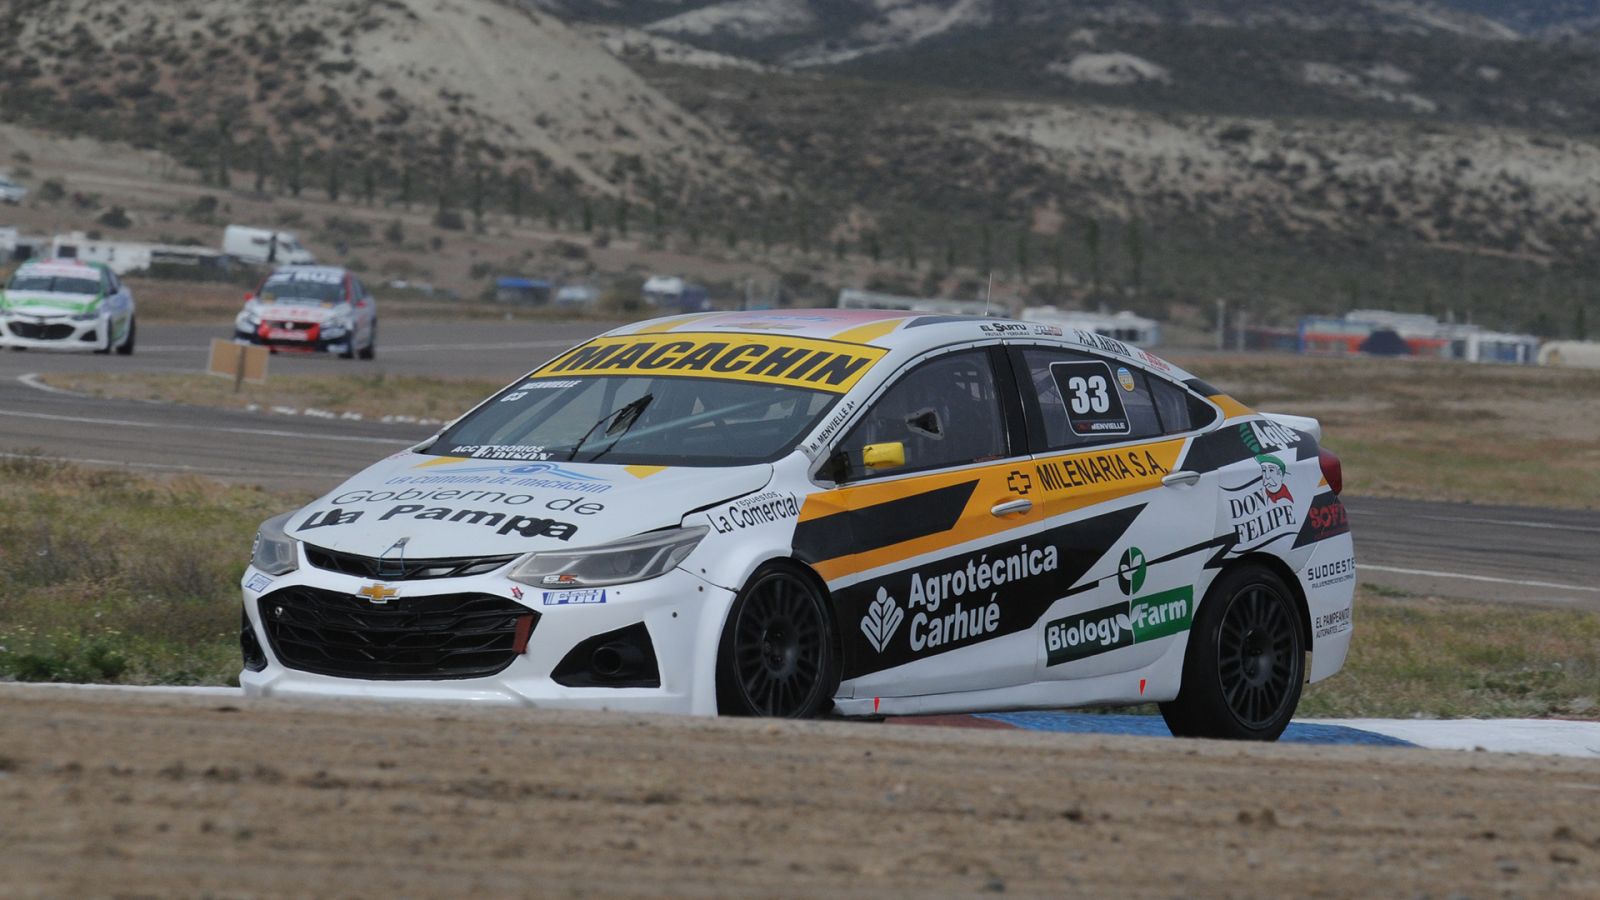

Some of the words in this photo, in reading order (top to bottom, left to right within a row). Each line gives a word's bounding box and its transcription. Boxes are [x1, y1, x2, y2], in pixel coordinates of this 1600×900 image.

[550, 341, 872, 386] MACACHIN
[1068, 375, 1110, 414] 33
[817, 407, 849, 444] MENVIELLE
[1036, 454, 1135, 492] MILENARIA
[1128, 450, 1168, 477] S.A.
[331, 486, 534, 505] Gobierno
[545, 496, 605, 516] de
[706, 513, 734, 534] La
[729, 491, 801, 529] Comercial
[735, 490, 778, 508] repuestos
[1228, 487, 1268, 519] DON
[1233, 504, 1297, 544] FELIPE
[908, 544, 1058, 612] Agrotécnica
[1308, 557, 1356, 581] SUDOESTE
[909, 592, 1001, 652] Carhué
[1048, 616, 1121, 651] Biology
[1137, 599, 1188, 629] Farm
[1315, 616, 1322, 629] EL
